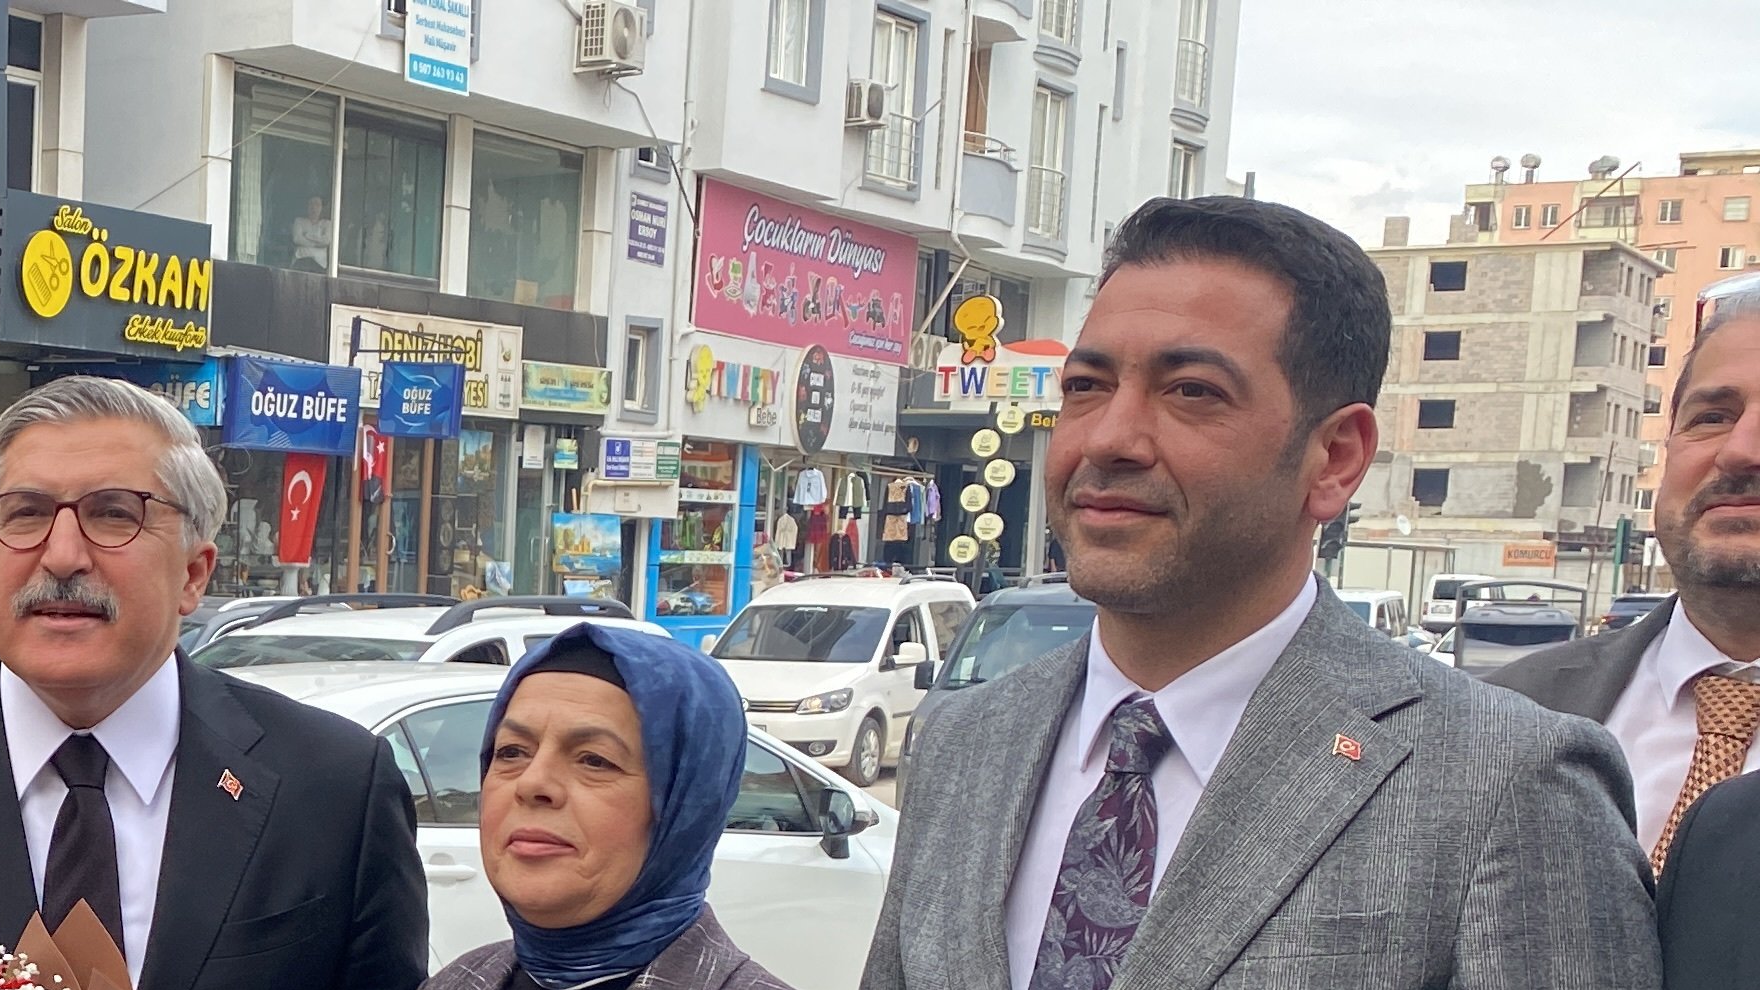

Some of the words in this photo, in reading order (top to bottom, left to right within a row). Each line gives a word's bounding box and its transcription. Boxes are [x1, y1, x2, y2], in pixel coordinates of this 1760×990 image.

[54, 204, 92, 234] Salon
[742, 204, 827, 260] Çocukların
[827, 227, 887, 279] Dünyası
[80, 228, 210, 312] ÖZKAN
[125, 314, 162, 343] Erkek
[251, 387, 299, 419] OĞUZ
[302, 391, 348, 422] BÜFE
[402, 399, 431, 415] BÜFE
[403, 386, 432, 401] OĞUZ
